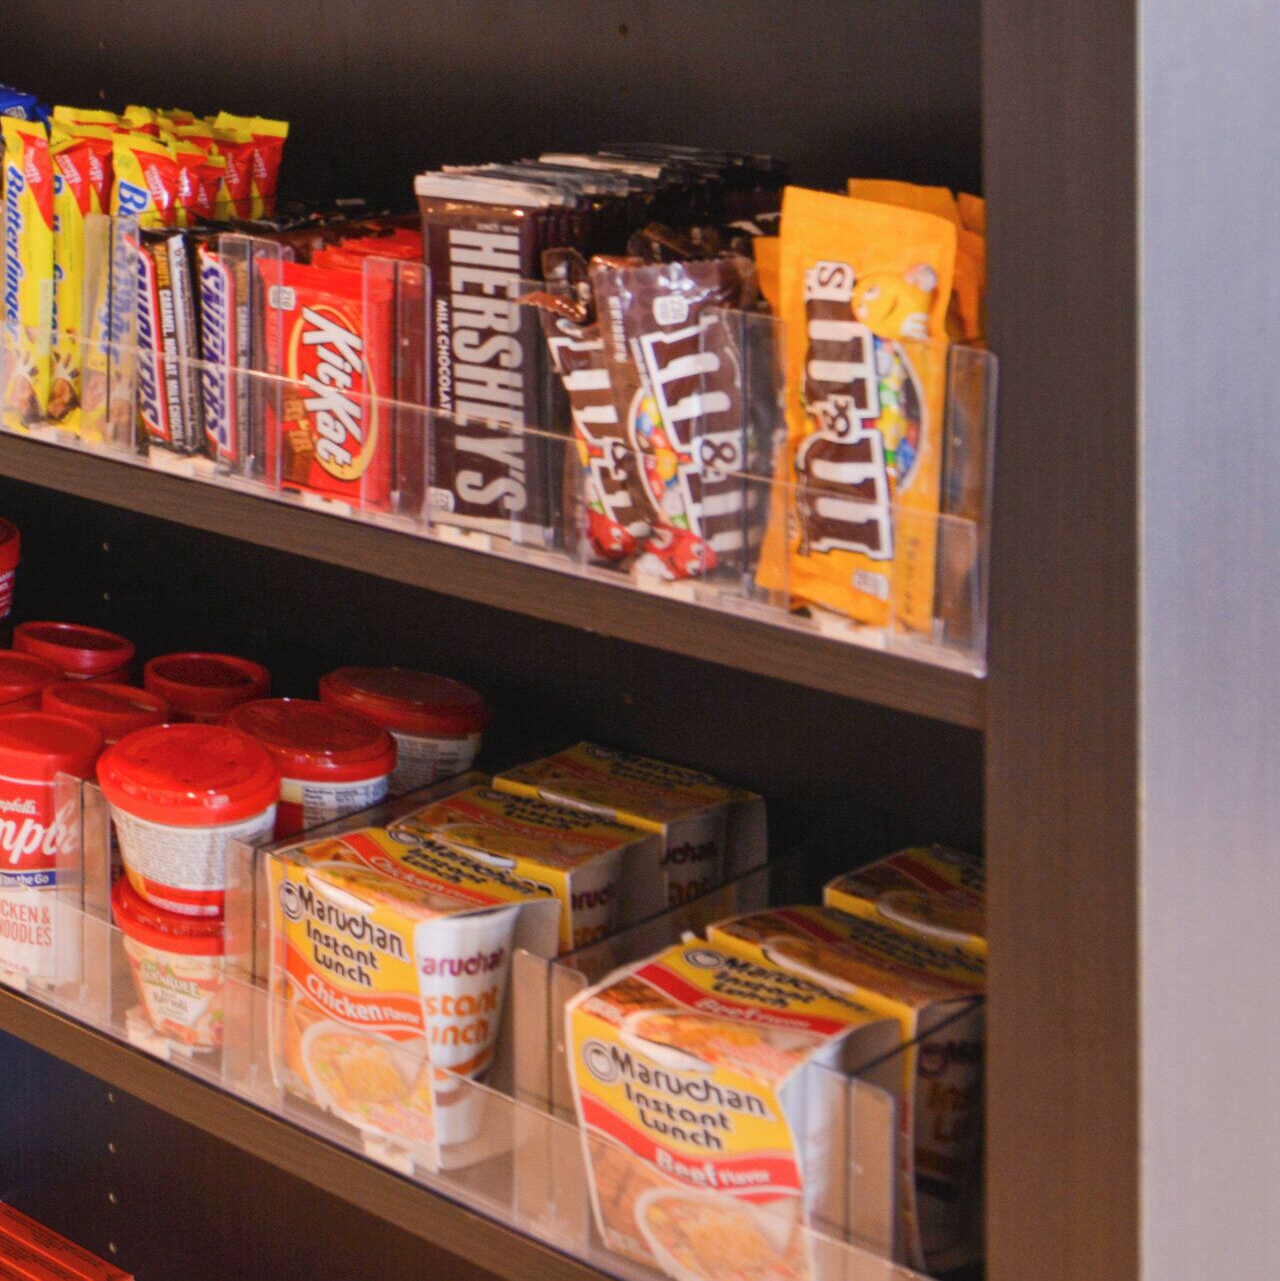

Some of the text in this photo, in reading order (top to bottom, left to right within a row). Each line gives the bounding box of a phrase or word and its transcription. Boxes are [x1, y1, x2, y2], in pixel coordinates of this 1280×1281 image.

[3, 164, 25, 343] Butterfinger
[437, 299, 453, 420] MILK CHOCOLATE
[448, 229, 528, 514] HERSHEY'S
[34, 872, 49, 885] Go
[40, 908, 51, 925] &
[298, 884, 408, 959] Maruchan
[306, 918, 380, 971] Instant
[314, 938, 373, 989] Lunch
[306, 972, 381, 1020] Chicken
[611, 1044, 767, 1119] Maruchan
[625, 1081, 733, 1132] Instant
[638, 1108, 723, 1153] Lunch
[655, 1147, 719, 1189] Beef
